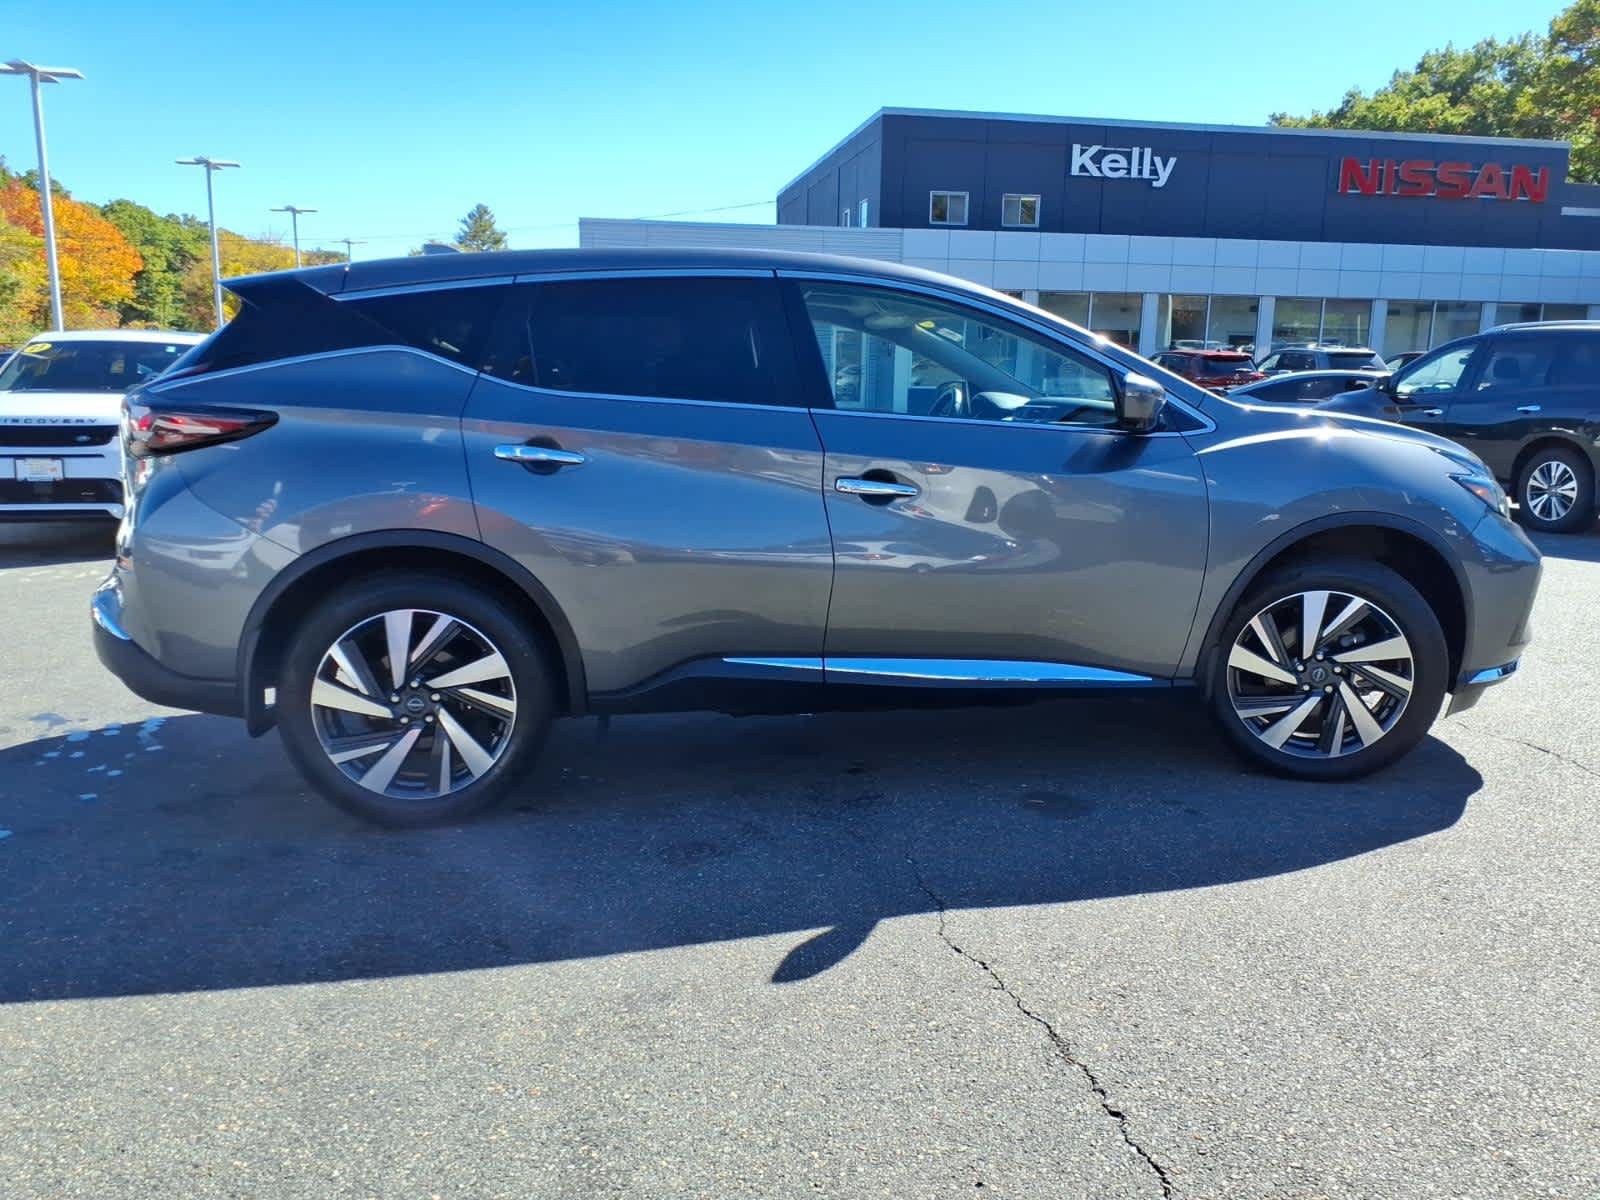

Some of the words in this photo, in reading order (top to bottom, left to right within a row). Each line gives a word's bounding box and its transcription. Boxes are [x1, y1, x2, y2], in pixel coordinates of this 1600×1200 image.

[1071, 143, 1177, 188] Kelly
[1338, 157, 1549, 203] NISSAN
[0, 417, 97, 425] ISCOVERY
